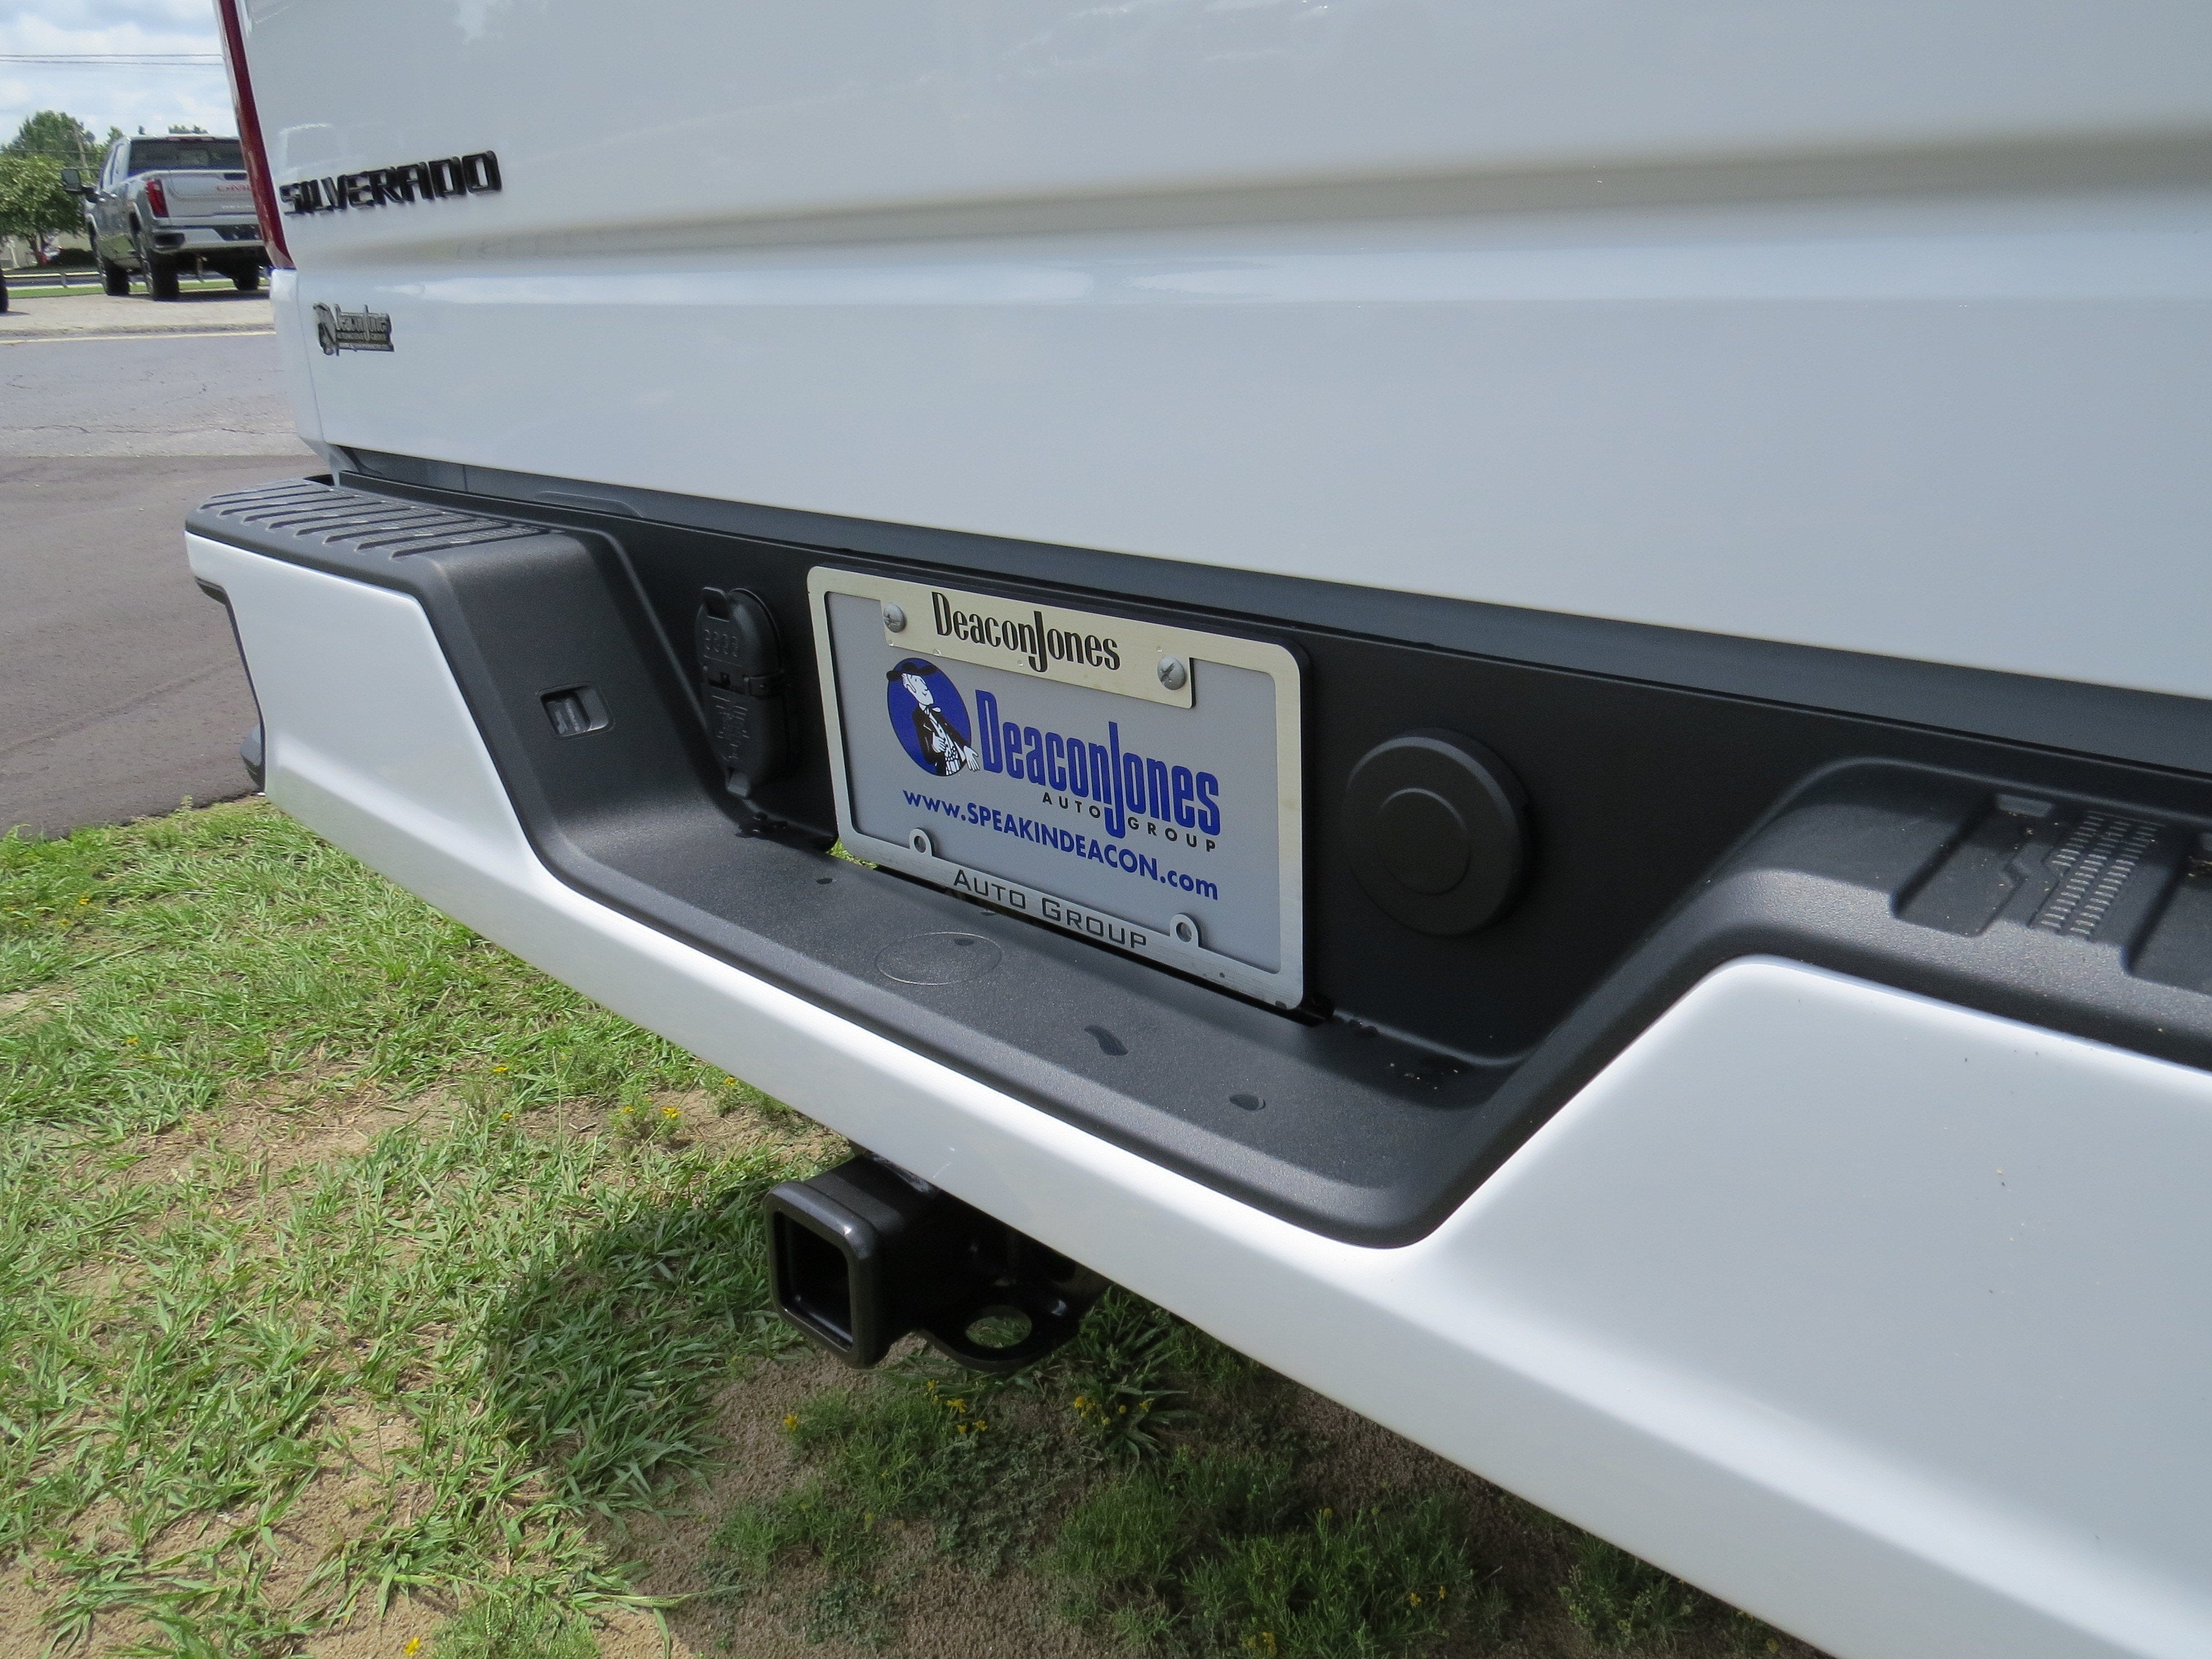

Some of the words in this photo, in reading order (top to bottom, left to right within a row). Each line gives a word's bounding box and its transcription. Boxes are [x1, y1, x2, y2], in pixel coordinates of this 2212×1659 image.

[279, 150, 502, 215] SILVERADO
[932, 591, 1120, 672] DeaconJones
[975, 689, 1220, 838] DeaconJones
[902, 790, 1218, 900] www.SPEAKINDEACON.com
[1042, 792, 1100, 818] AUTO
[1128, 816, 1216, 853] GROUP
